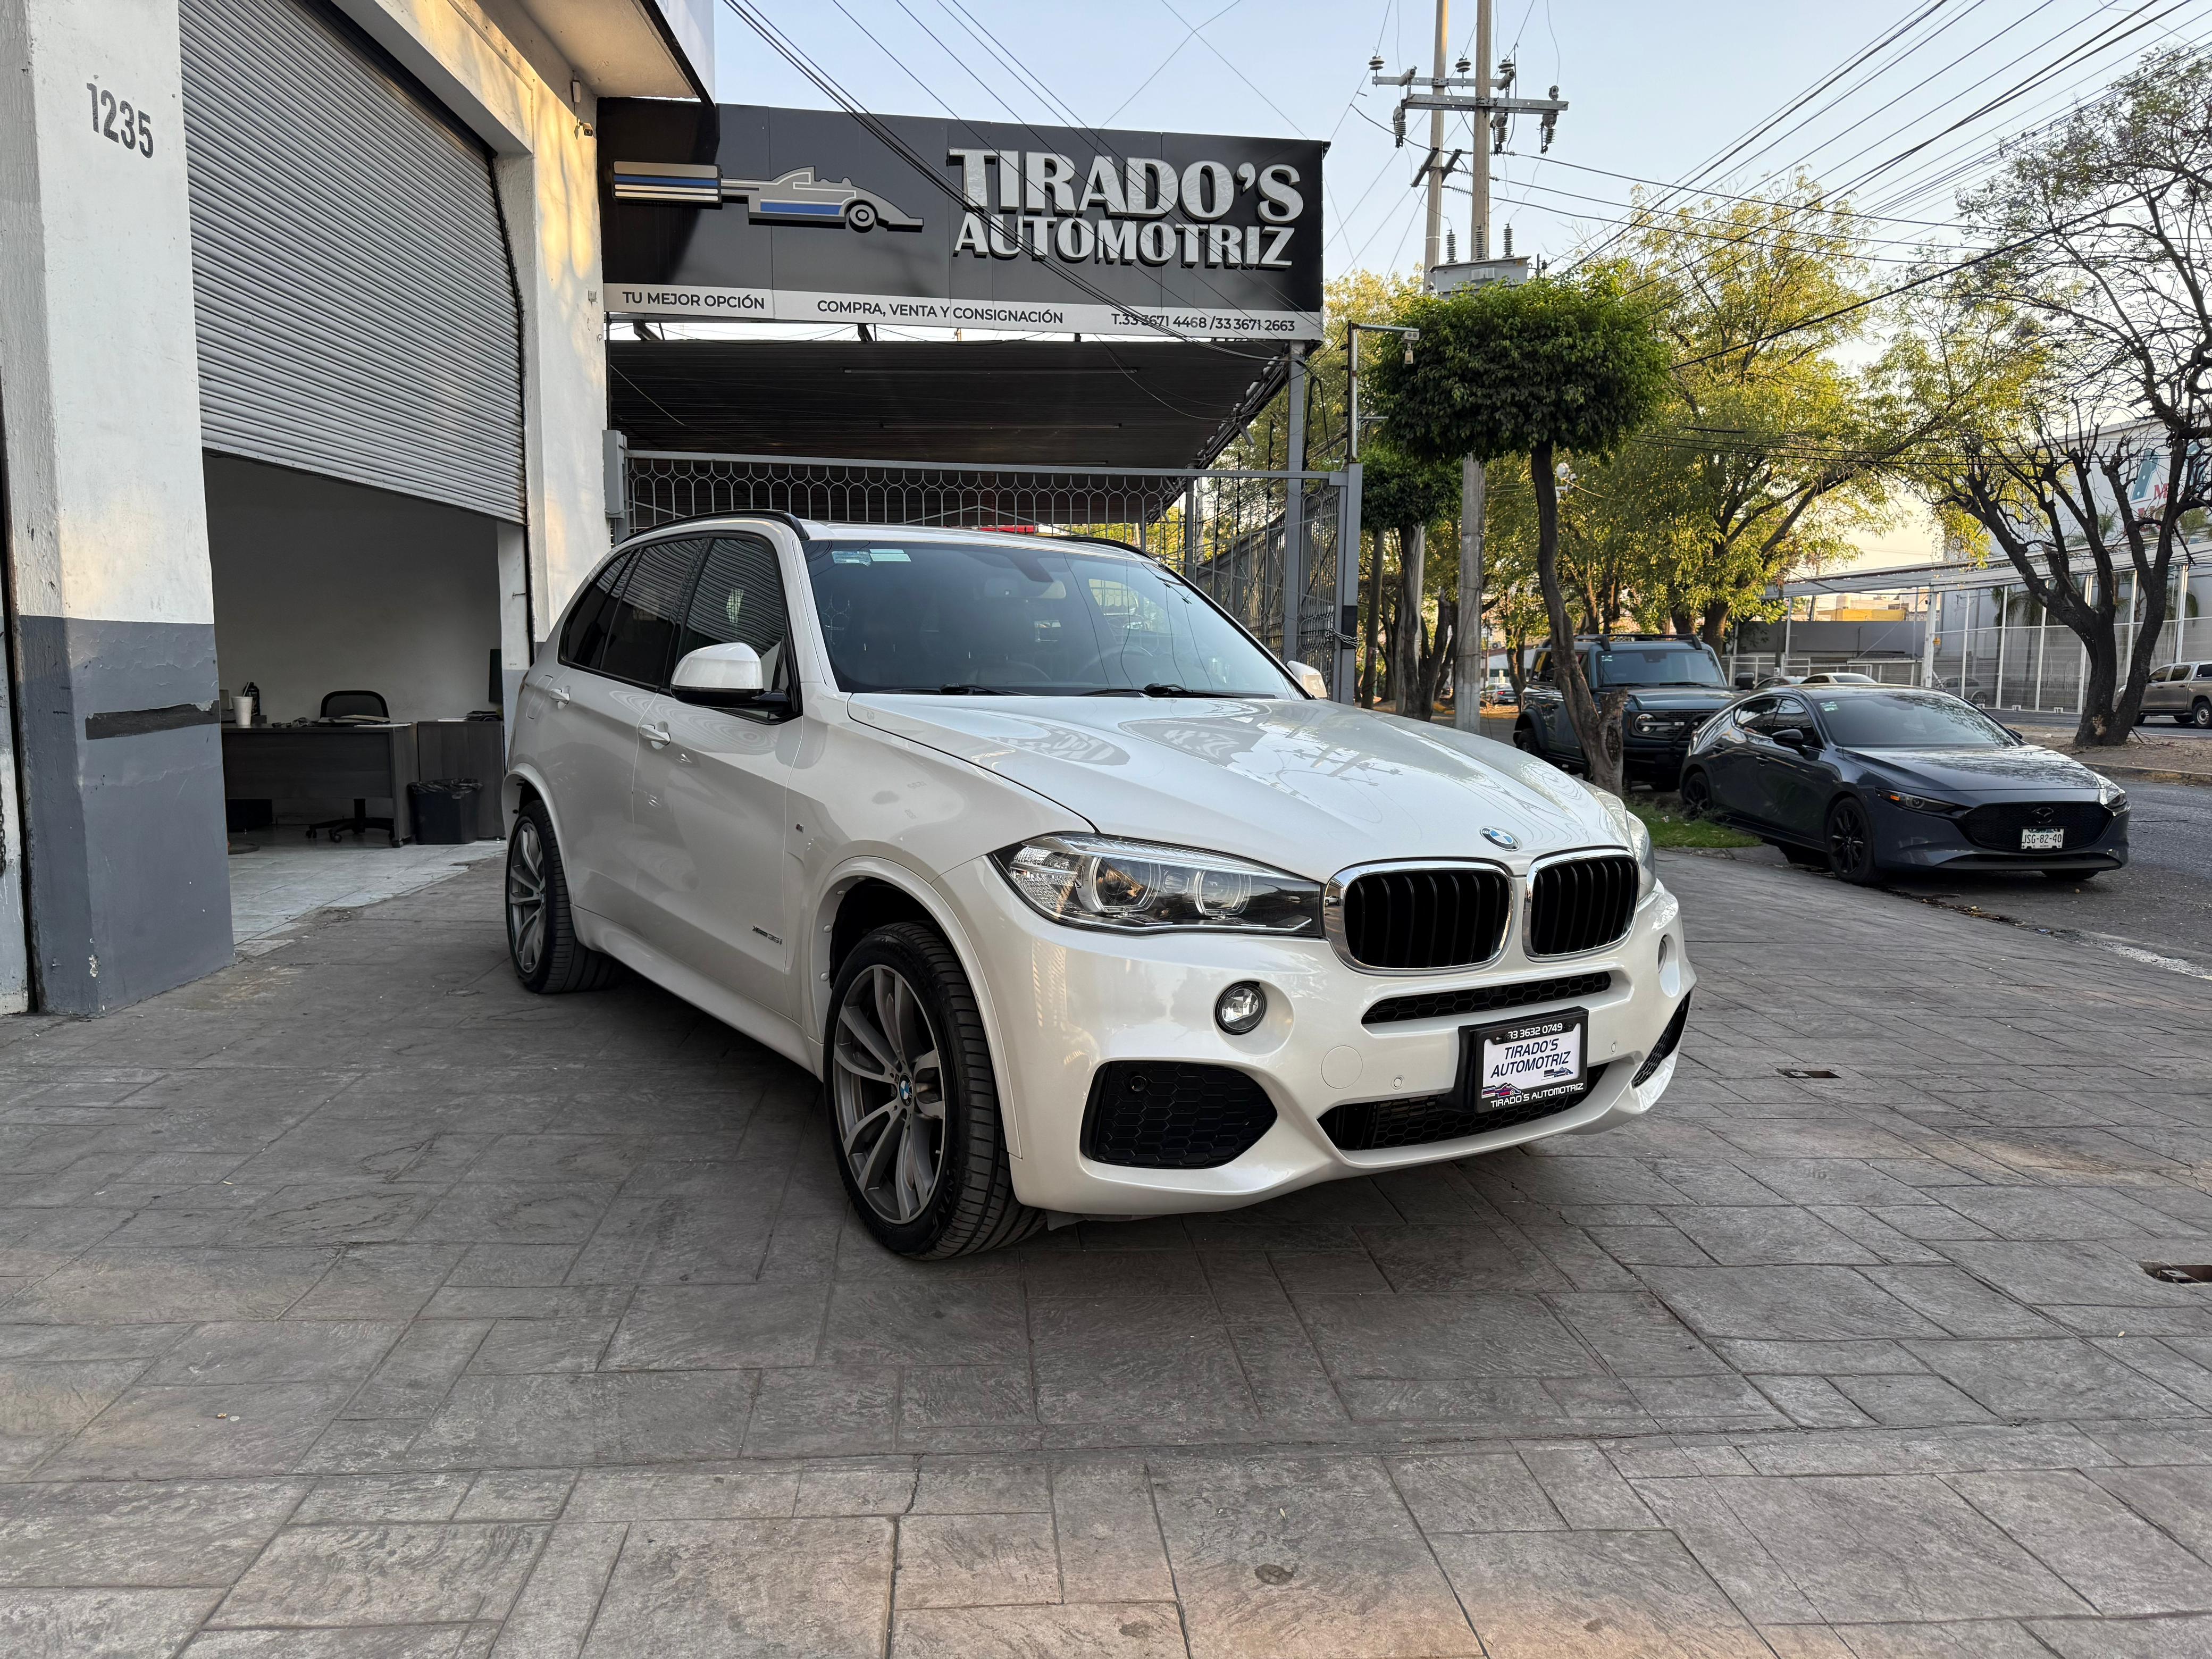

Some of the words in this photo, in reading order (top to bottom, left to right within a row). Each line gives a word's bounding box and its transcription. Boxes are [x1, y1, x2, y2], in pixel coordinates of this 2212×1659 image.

[86, 82, 154, 158] 1235
[947, 147, 1304, 223] TIRADO'S
[954, 212, 1295, 267] AUTOMOTRIZ
[622, 291, 642, 304] TU
[647, 292, 701, 306] MEJOR
[704, 294, 765, 309] OPCIÓN
[817, 299, 886, 317] COMPRA,
[889, 304, 937, 317] VENTA
[940, 306, 950, 318] Y
[953, 307, 1063, 324] CONSIGNACIÓN
[1172, 315, 1207, 329] 4468
[1233, 318, 1262, 331] 3671
[1264, 319, 1295, 331] 2663
[1519, 1026, 1540, 1038] 3632
[1542, 1023, 1563, 1034] 0749
[1504, 1038, 1560, 1060] TIRADO'S
[1490, 1051, 1571, 1078] AUTOMOTRIZ
[1490, 1092, 1530, 1108] TIRADO'S
[1531, 1083, 1584, 1100] AUTOMOTRIZ
